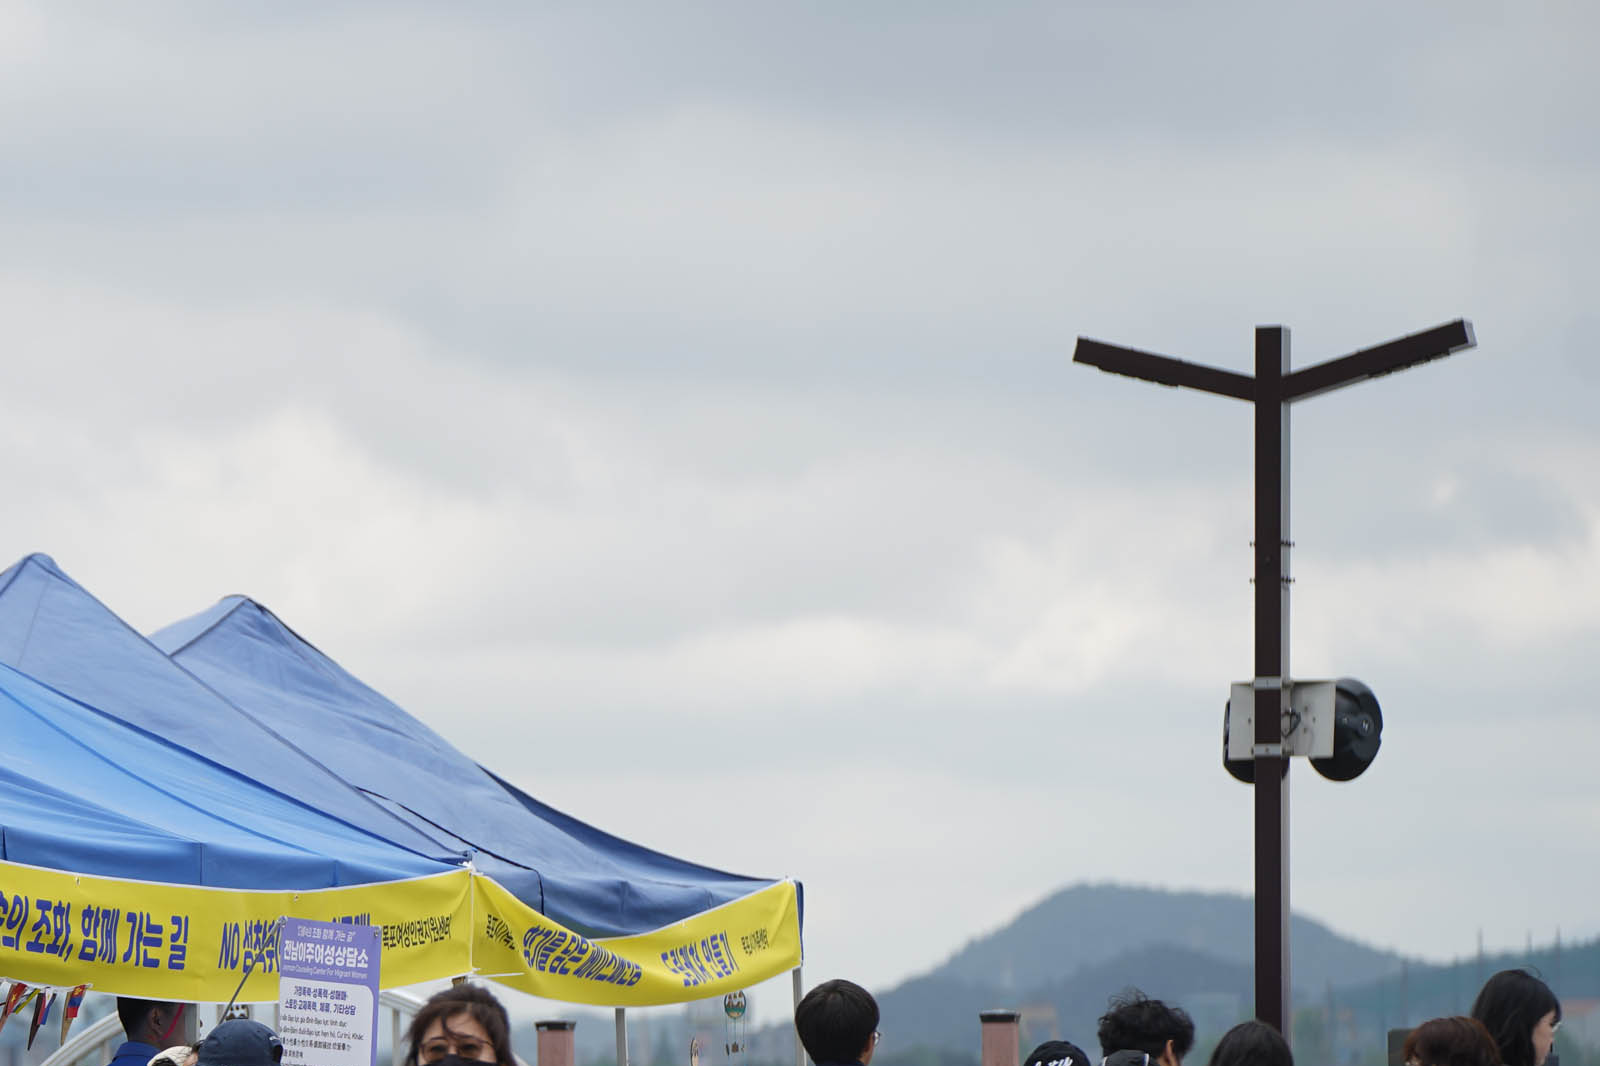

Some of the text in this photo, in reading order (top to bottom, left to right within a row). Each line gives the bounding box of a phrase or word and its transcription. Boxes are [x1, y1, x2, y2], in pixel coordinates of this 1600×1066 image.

[26, 898, 75, 963] 조화,
[78, 903, 120, 965] 함께
[122, 911, 164, 968] 가는
[168, 915, 189, 970] 길
[218, 922, 240, 970] NO
[383, 914, 453, 951] 목포여성인권지원센터
[284, 940, 368, 968] 전남이주여성상담소
